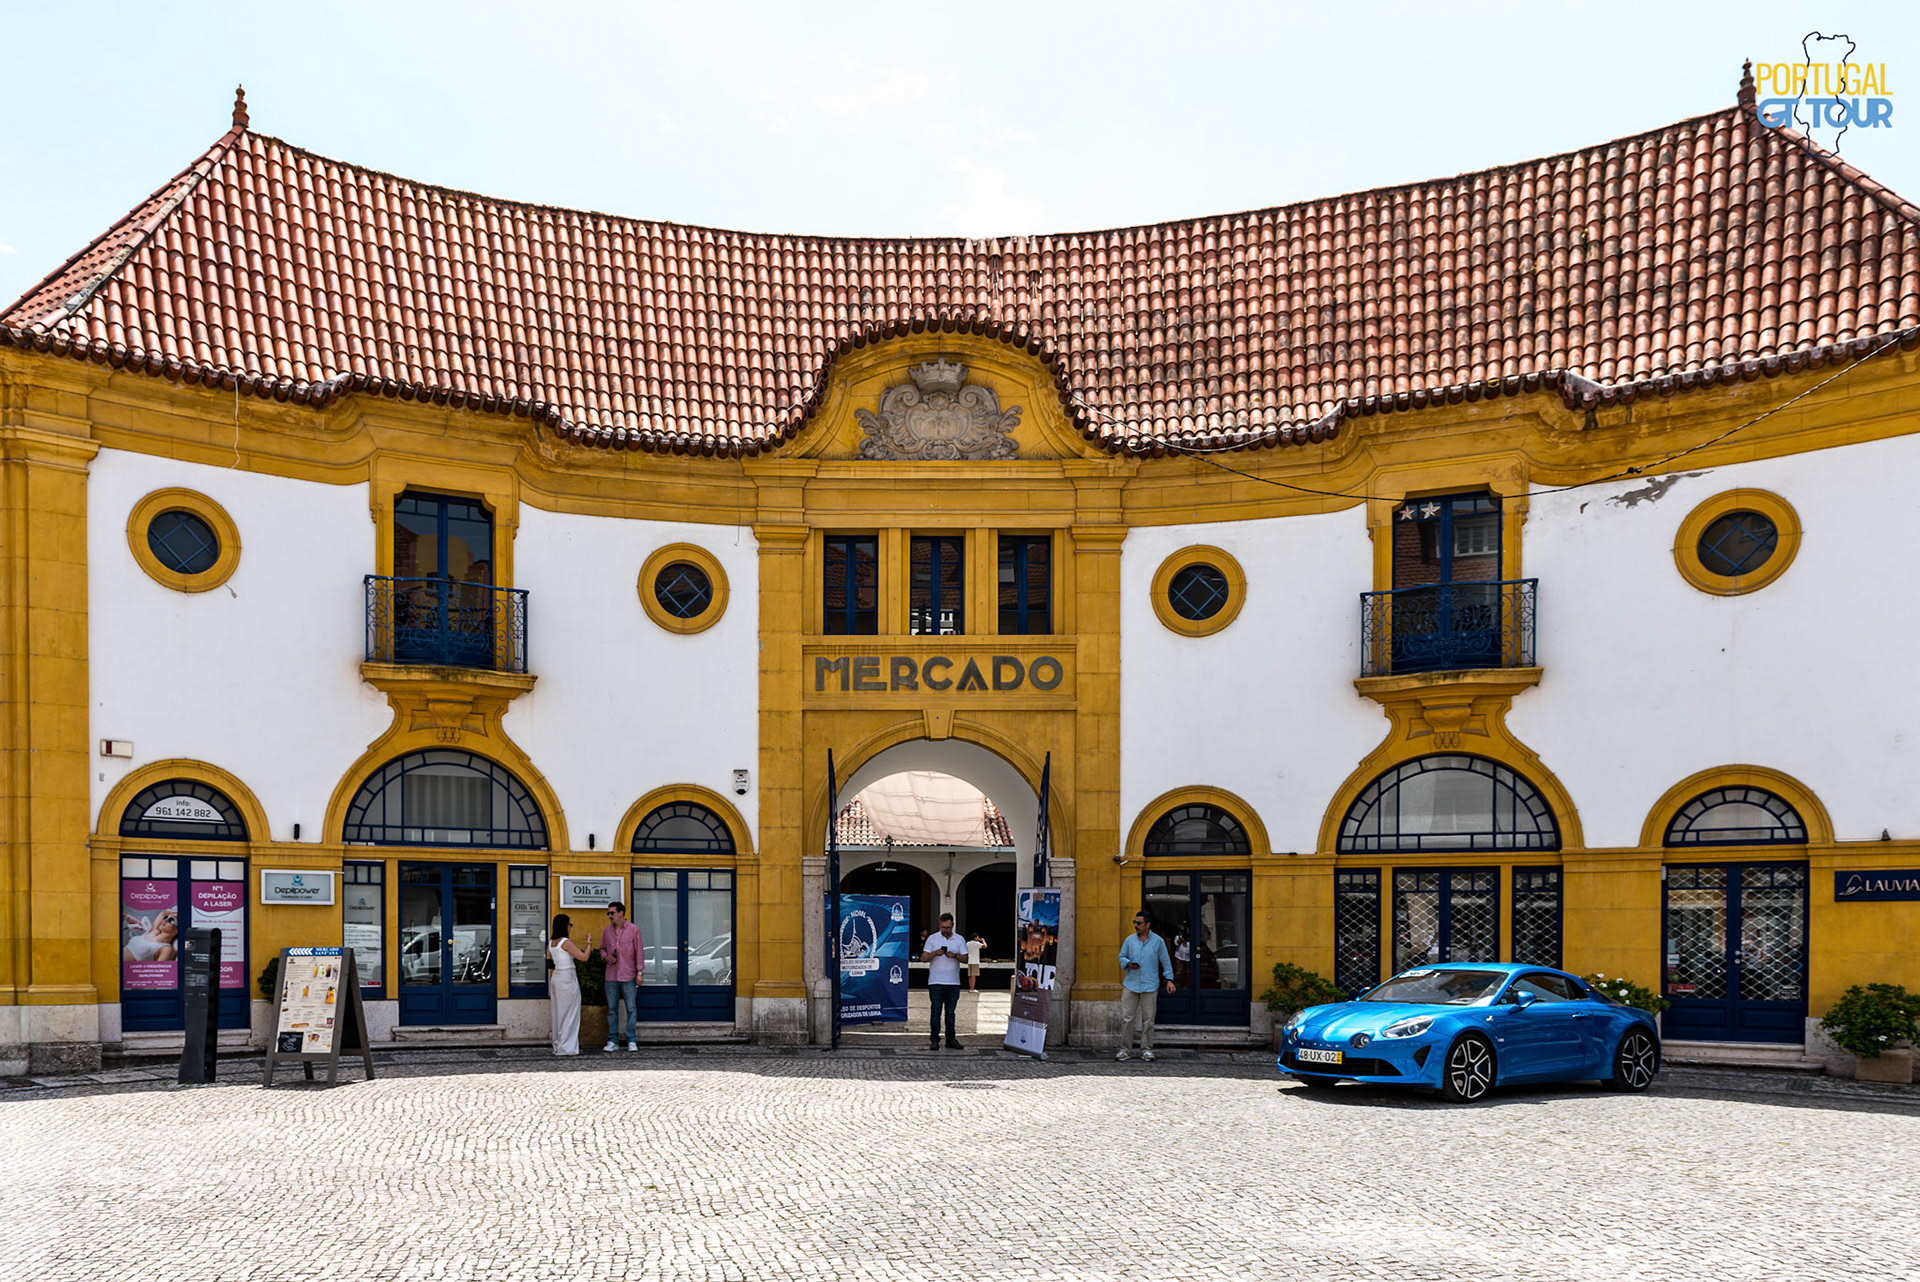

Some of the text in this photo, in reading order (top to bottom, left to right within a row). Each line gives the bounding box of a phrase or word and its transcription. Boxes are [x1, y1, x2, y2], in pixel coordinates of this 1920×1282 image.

[815, 656, 1063, 691] MERCADO
[155, 807, 211, 818] 961 142 882
[198, 892, 237, 900] DEPILAÇÃO
